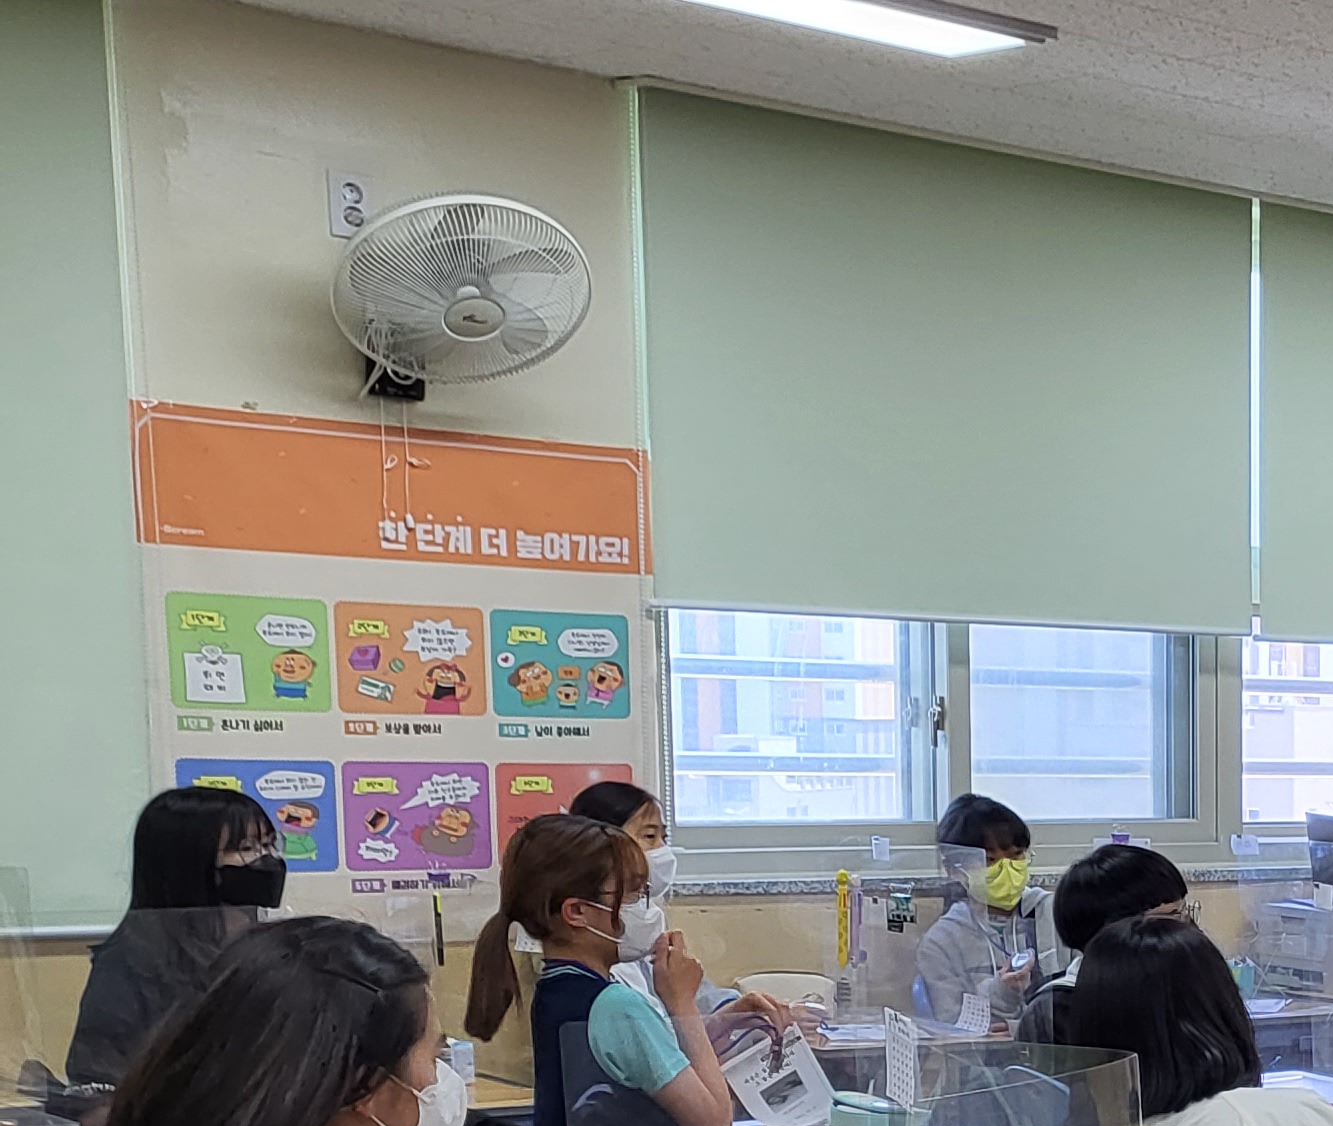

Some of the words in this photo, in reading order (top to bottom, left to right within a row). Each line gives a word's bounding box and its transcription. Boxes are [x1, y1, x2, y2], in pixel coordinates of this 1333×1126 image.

[378, 519, 410, 551] 한
[416, 522, 473, 555] 단계
[480, 527, 508, 557] 더
[517, 530, 630, 565] 높여가요!
